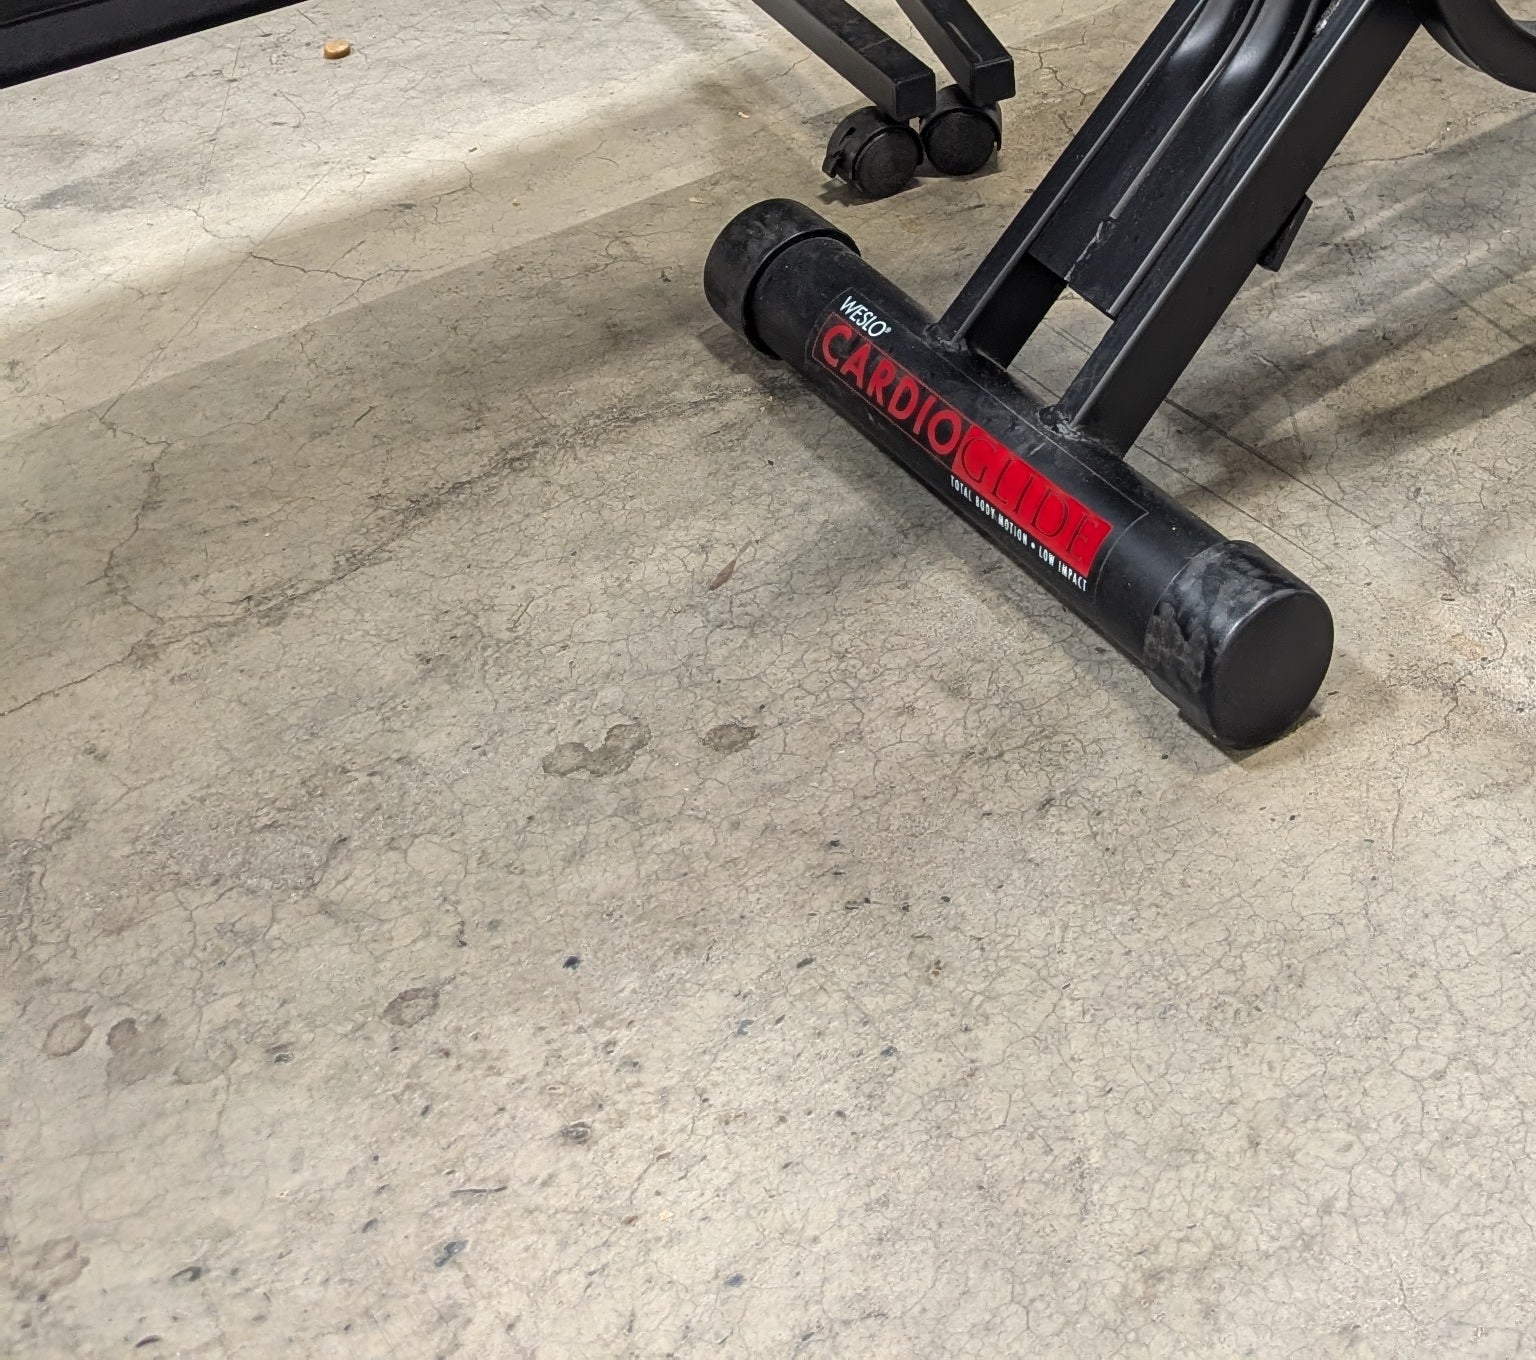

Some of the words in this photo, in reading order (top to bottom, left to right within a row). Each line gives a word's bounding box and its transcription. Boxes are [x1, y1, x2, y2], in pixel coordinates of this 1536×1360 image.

[950, 474, 973, 502] TOTAL
[975, 495, 996, 521] BODY
[997, 514, 1028, 546] MOTION
[1038, 545, 1056, 566] LOW
[1058, 560, 1088, 592] IMPACT
